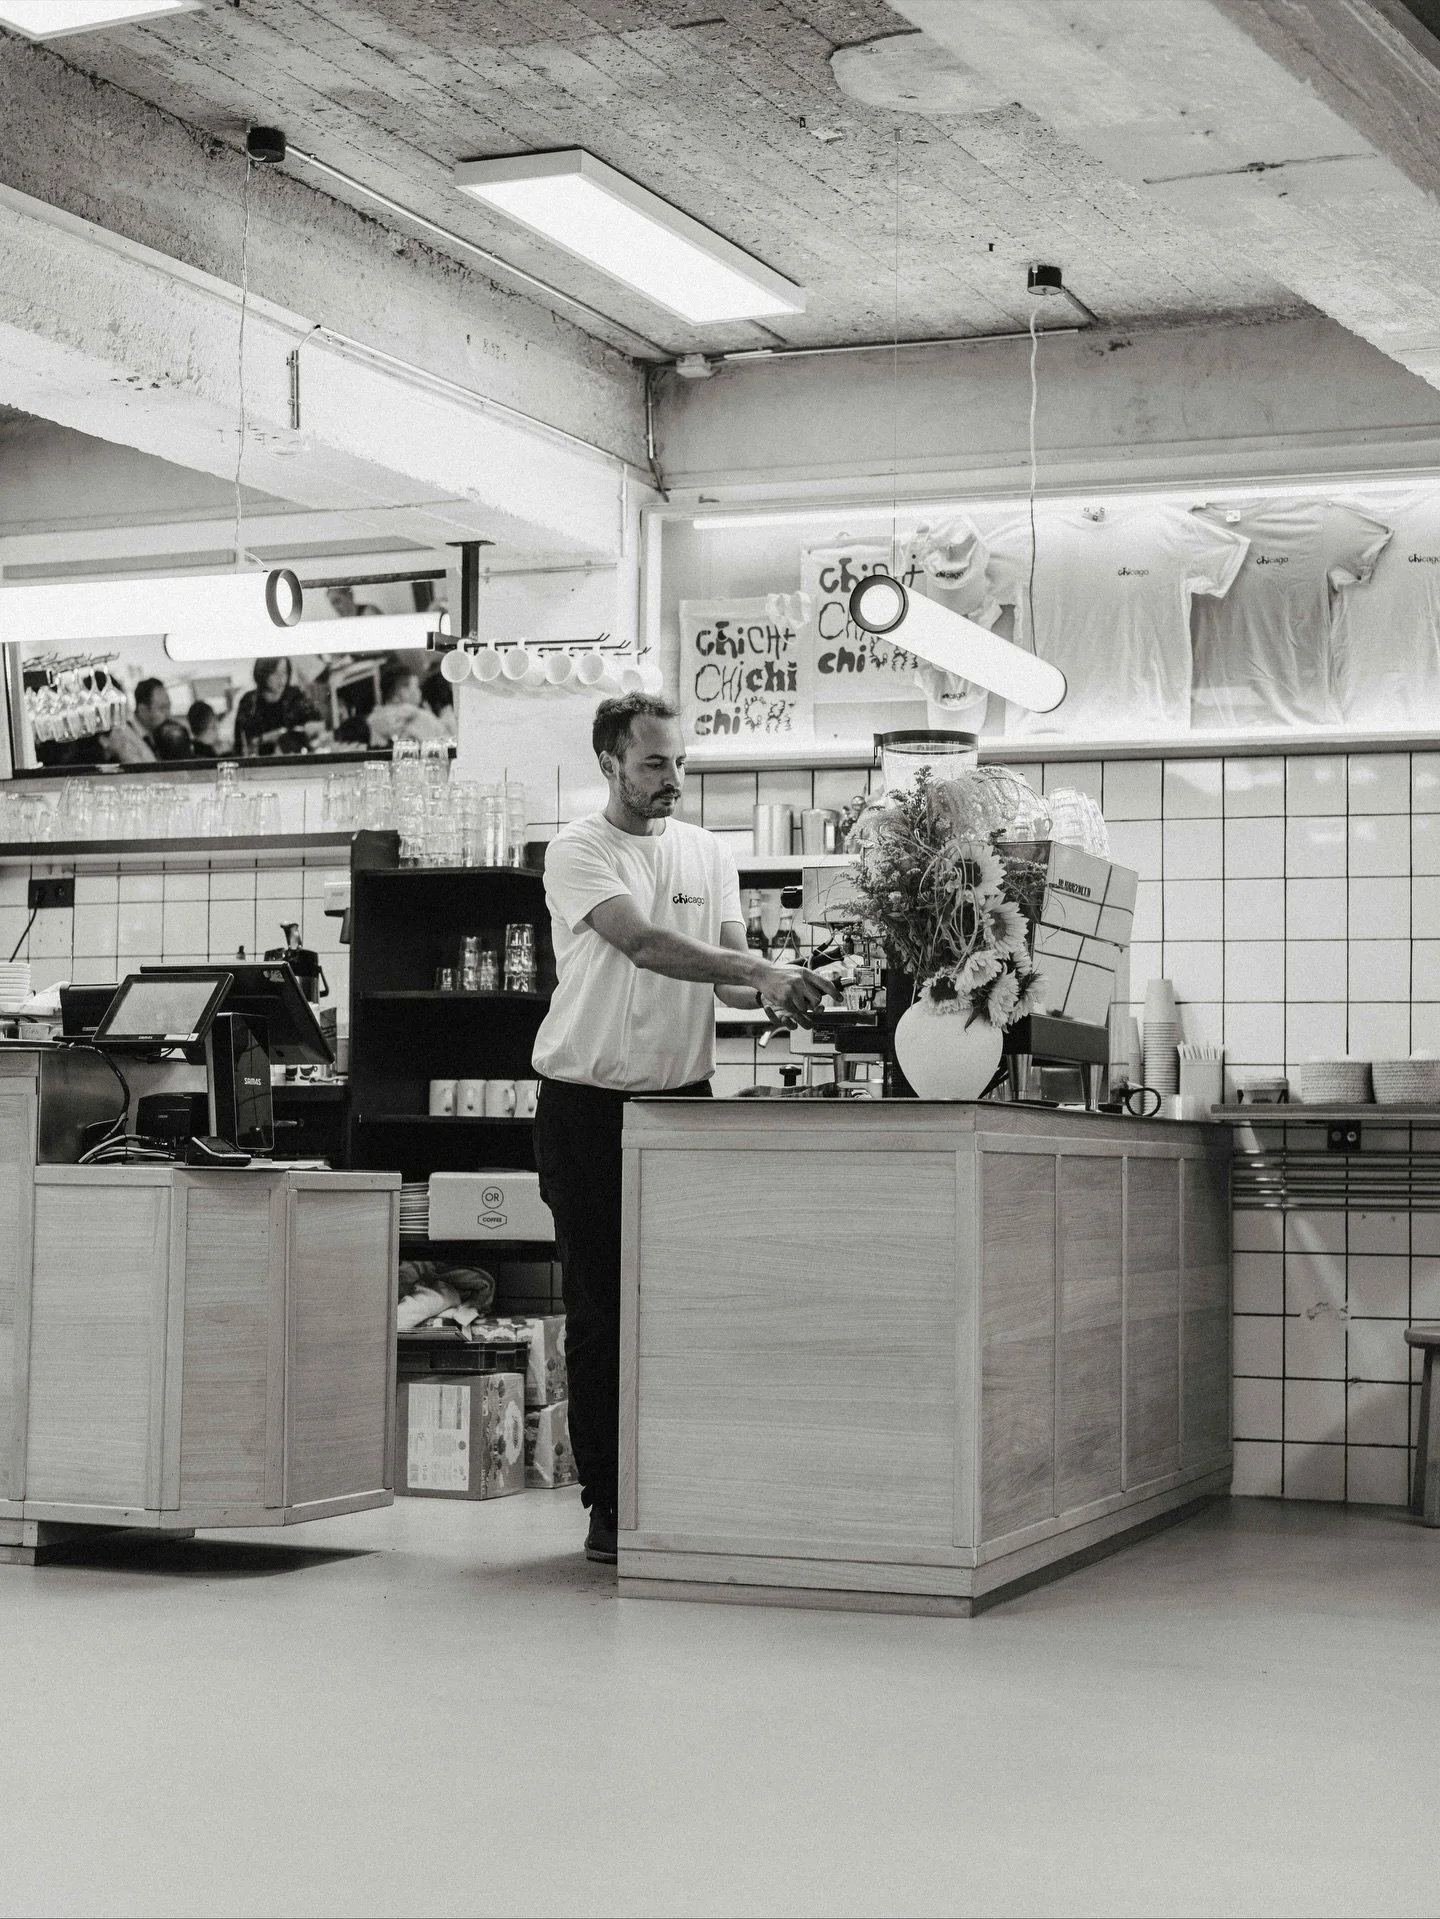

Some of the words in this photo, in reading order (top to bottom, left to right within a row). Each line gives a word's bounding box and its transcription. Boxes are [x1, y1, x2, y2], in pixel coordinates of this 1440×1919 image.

[1256, 555, 1289, 566] chicago
[1117, 567, 1150, 578] chicago
[672, 892, 705, 906] chicago
[485, 1192, 500, 1202] OR
